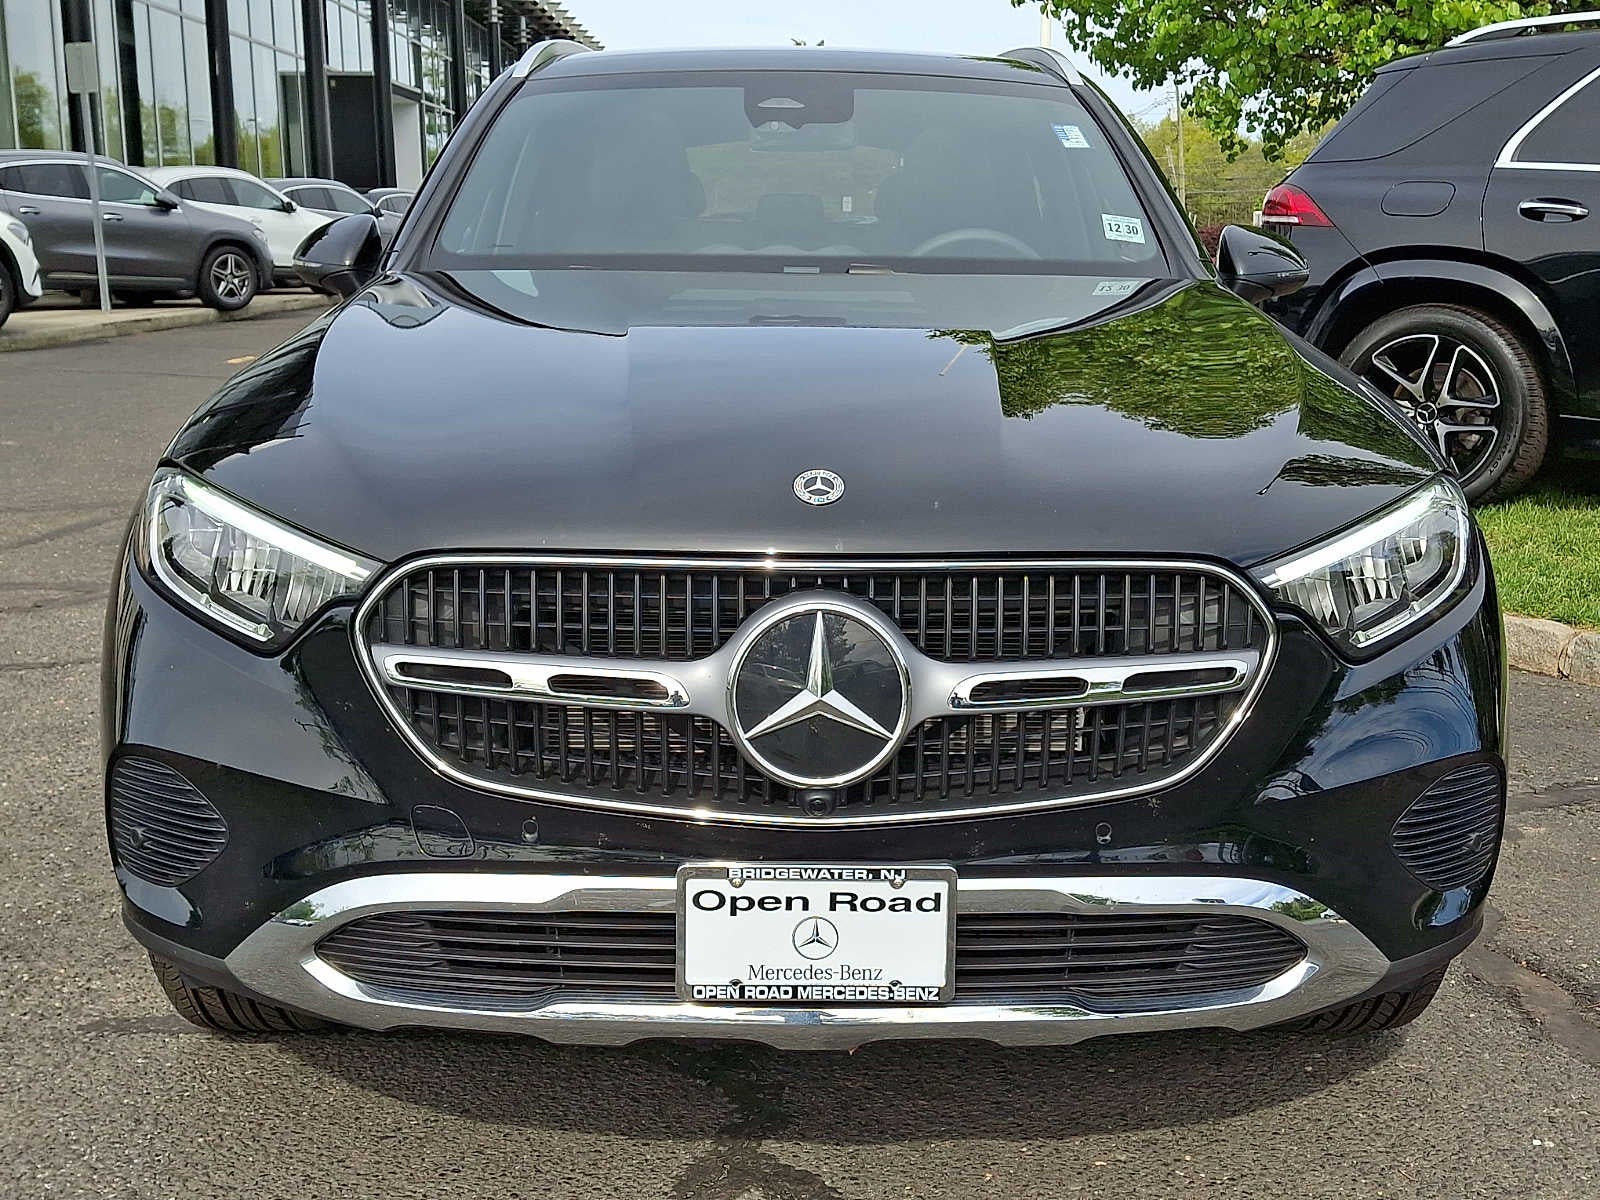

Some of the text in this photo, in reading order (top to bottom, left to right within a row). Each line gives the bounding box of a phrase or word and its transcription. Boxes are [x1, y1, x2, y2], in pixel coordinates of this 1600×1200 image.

[1107, 222, 1139, 235] 12 30
[728, 868, 906, 880] BRIDGEWATER, NJ
[692, 889, 941, 916] Open Road
[748, 964, 883, 981] Mercedes-Benz
[693, 986, 739, 999] OPEN
[744, 987, 793, 999] ROAD
